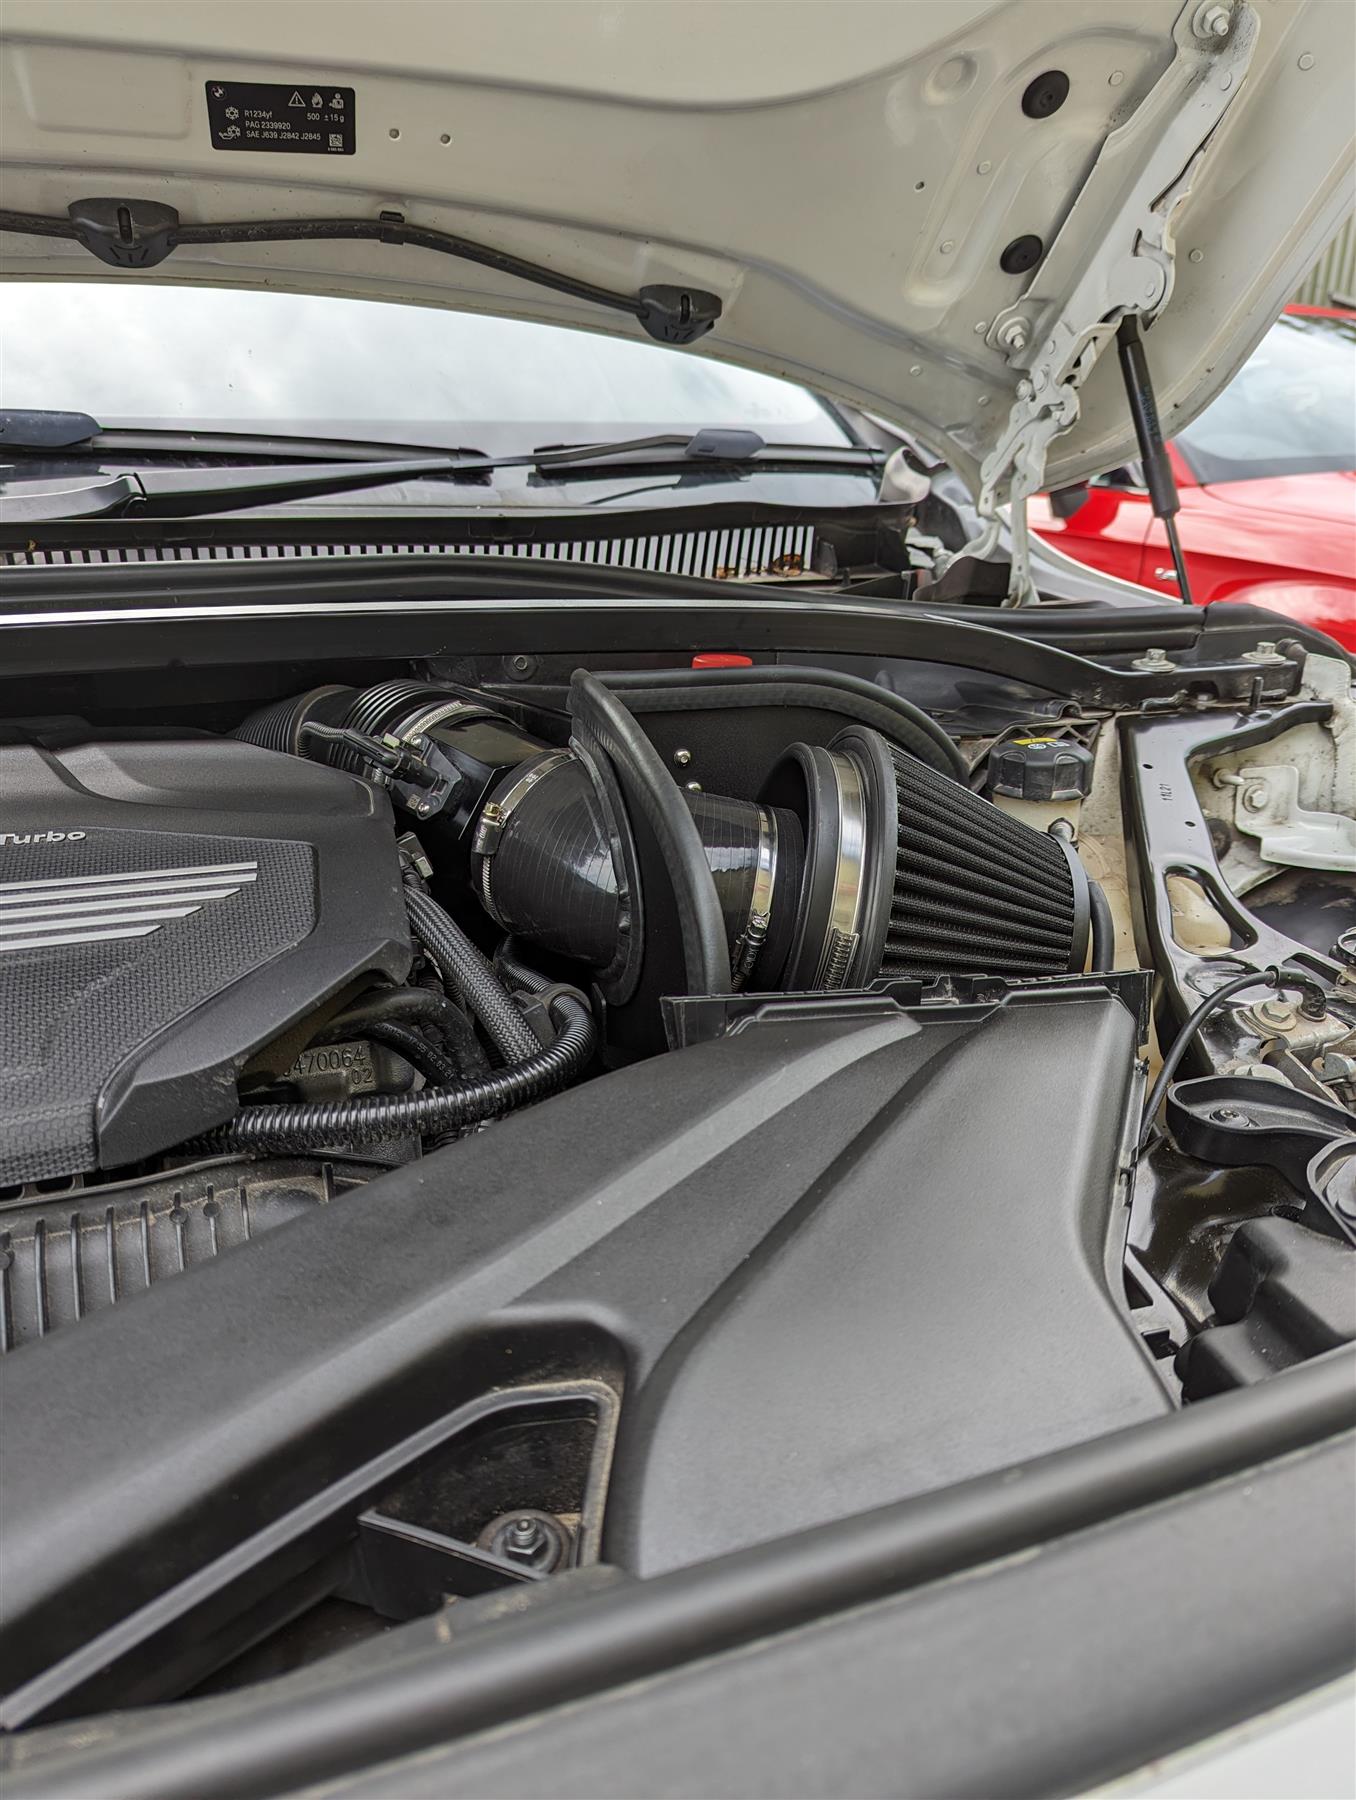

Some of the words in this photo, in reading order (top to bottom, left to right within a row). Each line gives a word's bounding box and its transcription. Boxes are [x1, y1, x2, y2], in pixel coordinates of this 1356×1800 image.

[306, 112, 320, 121] 500
[245, 120, 260, 129] PAG
[261, 121, 291, 130] 2339920
[246, 130, 260, 138] SAE
[283, 1044, 367, 1078] 470064
[351, 1067, 374, 1086] 02
